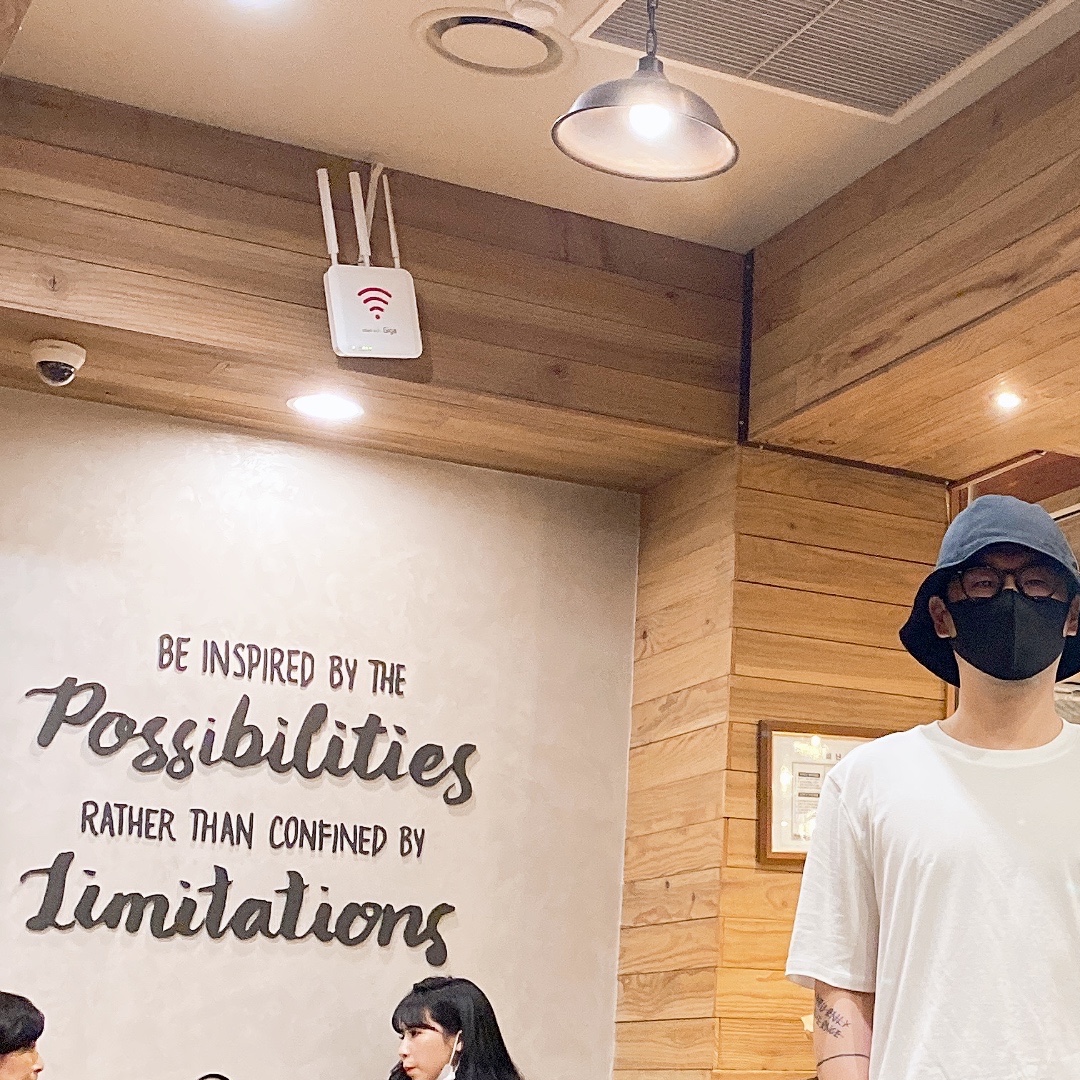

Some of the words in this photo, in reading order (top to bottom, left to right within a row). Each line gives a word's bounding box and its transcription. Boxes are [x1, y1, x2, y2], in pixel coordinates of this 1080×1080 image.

[158, 633, 191, 672] BE
[202, 639, 315, 688] INSPIRED
[329, 655, 358, 691] BY
[367, 659, 406, 696] THE
[24, 676, 477, 806] Possibilities
[81, 800, 177, 842] RATHER
[189, 808, 254, 850] THAN
[269, 815, 388, 858] CONFINED
[399, 825, 426, 858] BY
[19, 851, 456, 968] Limitations
